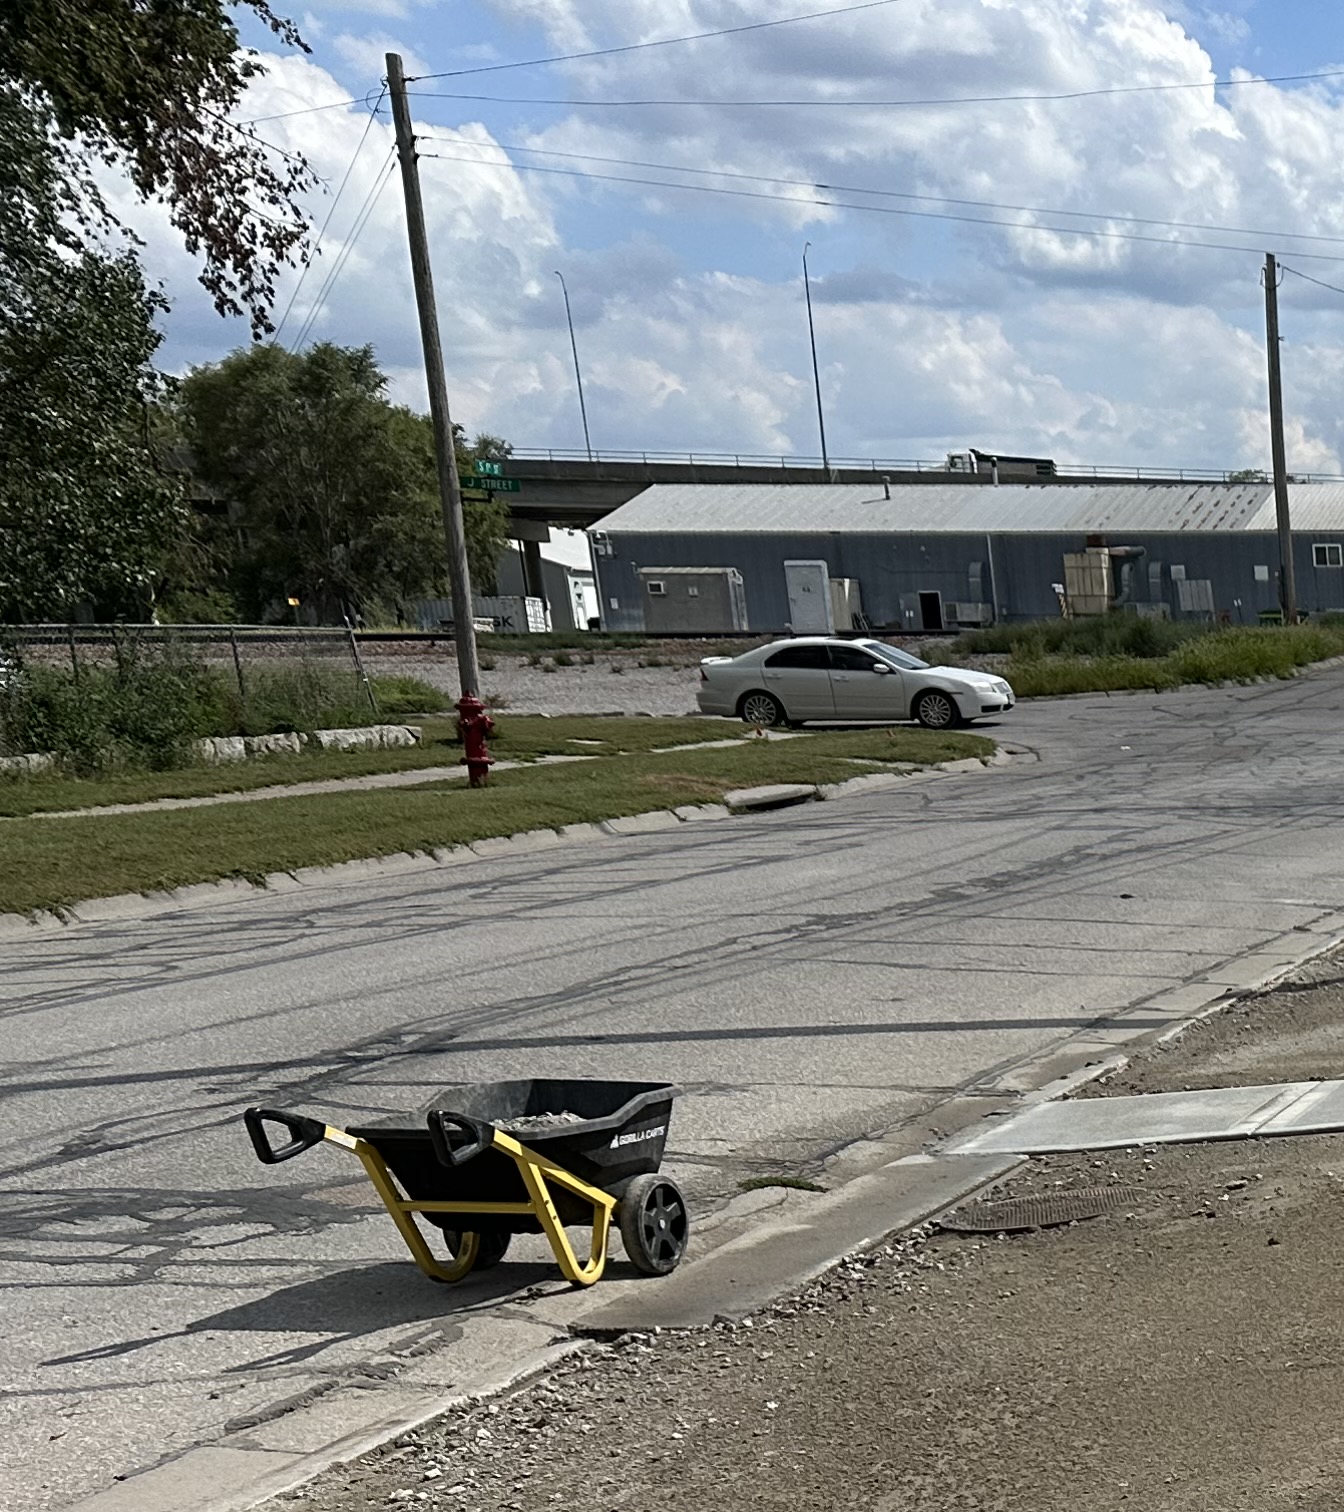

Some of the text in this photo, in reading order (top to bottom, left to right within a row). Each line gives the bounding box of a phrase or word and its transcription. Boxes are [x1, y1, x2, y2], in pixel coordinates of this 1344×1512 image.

[467, 479, 512, 490] J STREET
[619, 1125, 665, 1145] GORILLA CARTS
